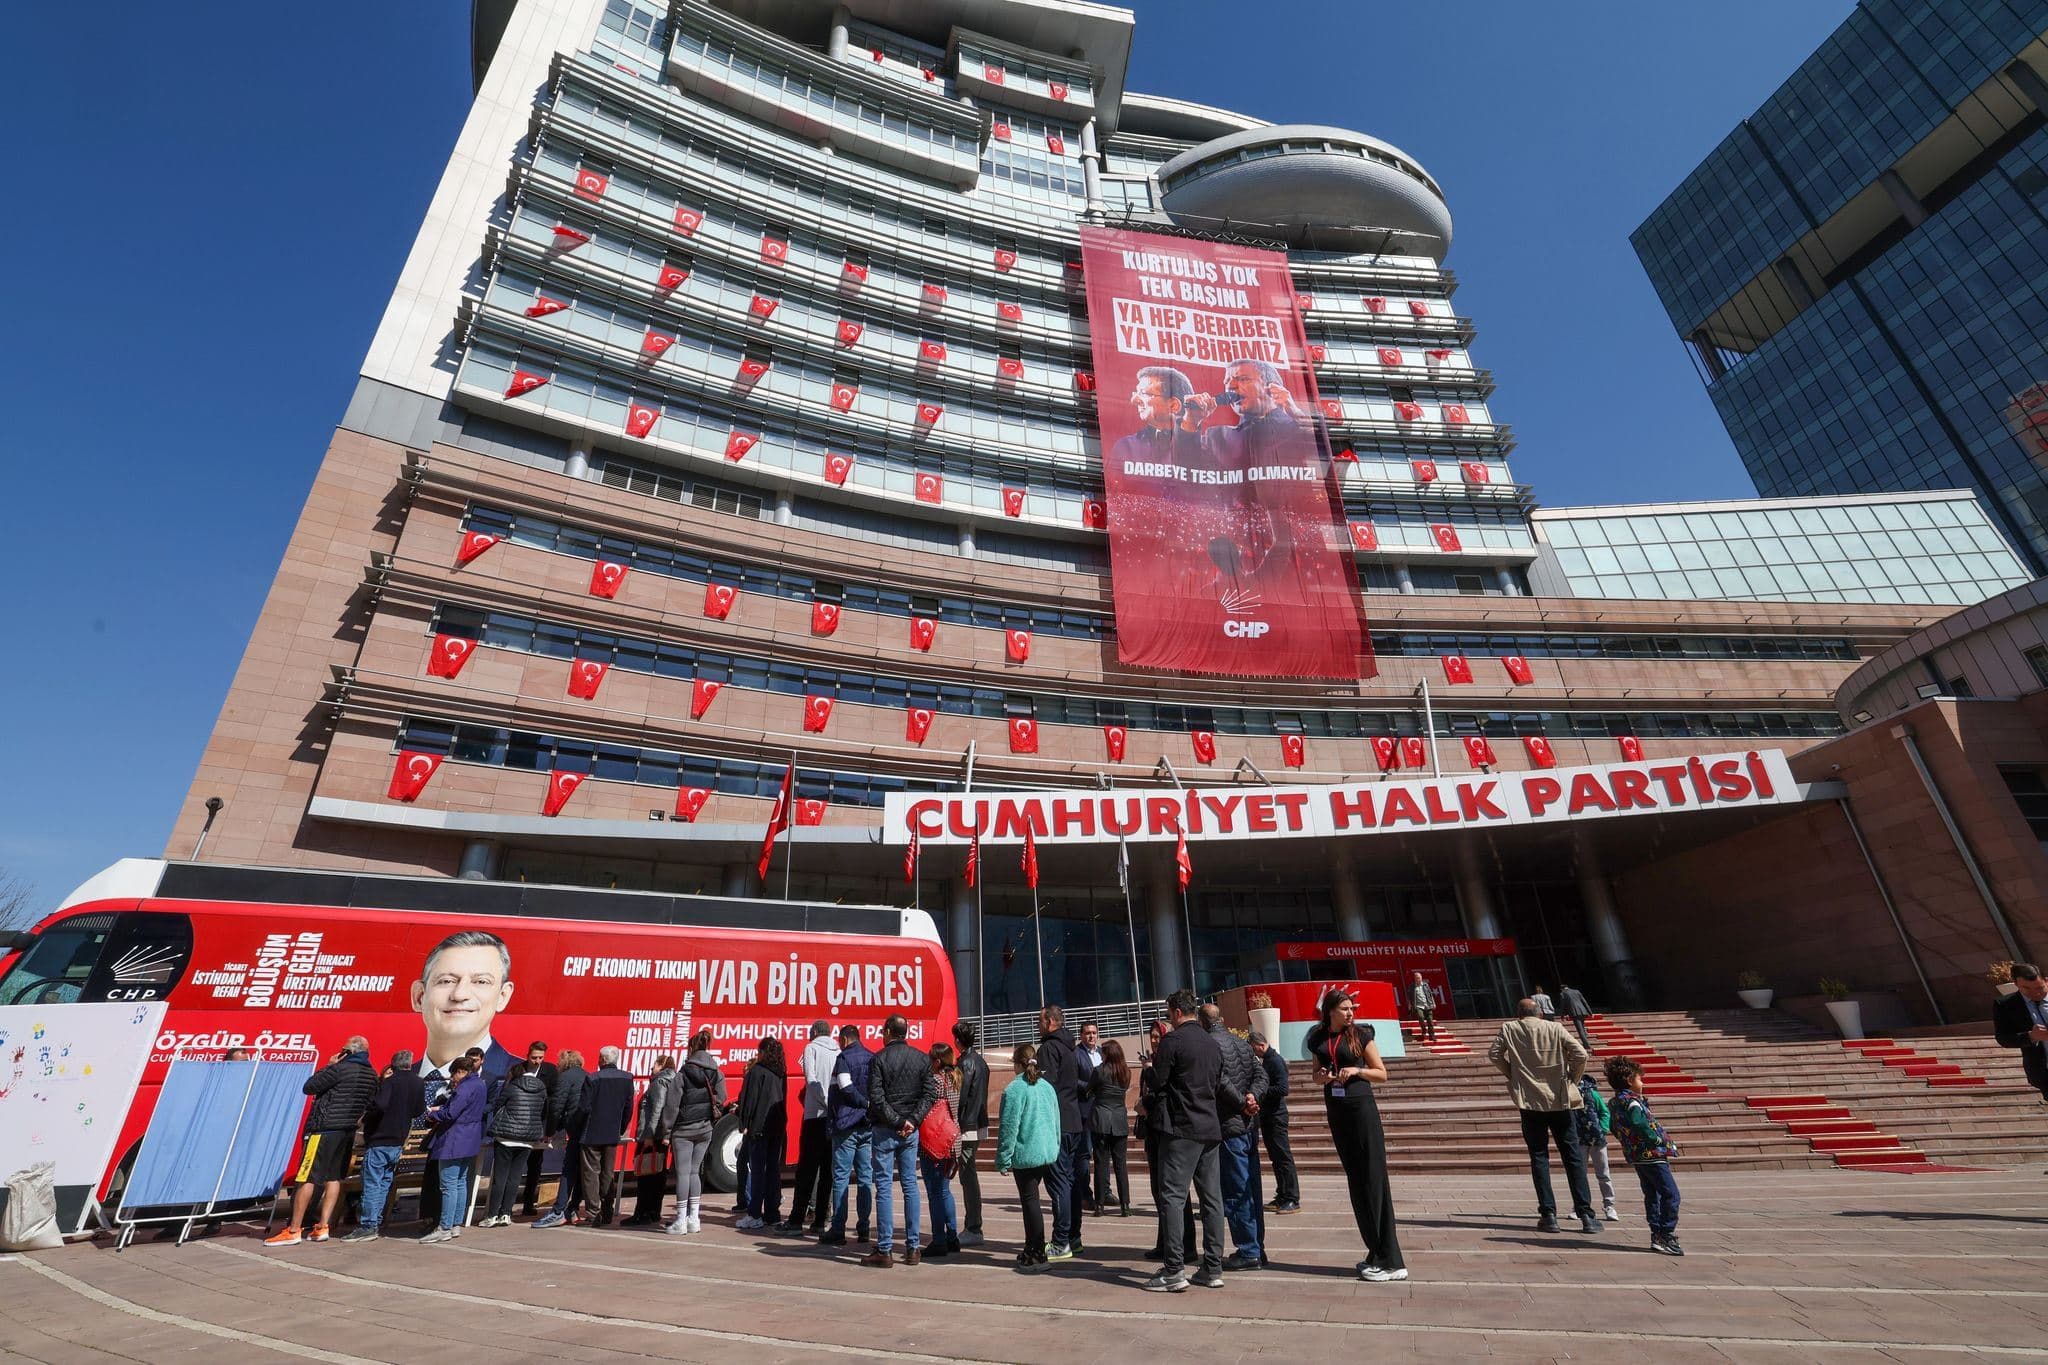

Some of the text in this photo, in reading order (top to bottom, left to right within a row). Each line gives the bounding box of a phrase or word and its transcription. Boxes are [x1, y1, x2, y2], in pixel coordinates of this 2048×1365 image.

[1122, 250, 1260, 287] KURTULUŞ YOK
[1139, 276, 1250, 309] TEK BAŞINA
[1117, 302, 1280, 339] YA HEP BERABER
[1120, 325, 1151, 352] YA
[1124, 460, 1316, 484] DARBEYE TESLİM OLMAYIZ!
[1223, 620, 1269, 638] CHP
[906, 751, 1776, 838] CUMHURİYET HALK PARTİSİ
[288, 932, 324, 974] GELİR
[1327, 942, 1469, 956] CUMHURİYET HALK PARTİSİ
[316, 952, 355, 967] İHRACAT
[564, 956, 696, 980] CHP EKONOMİ TAKIMI
[192, 969, 245, 985] İSTİHDAM
[242, 934, 292, 1007] BÖLÜŞÜM
[212, 985, 242, 998] REFAH
[282, 973, 395, 992] ÜRETİM TASARRUF
[699, 952, 923, 1015] VAR BİR ÇARESİ
[107, 989, 156, 999] CHP
[310, 992, 343, 1009] GELİR
[155, 1030, 315, 1049] ÖZGÜR ÖZEL
[626, 1027, 661, 1047] GIDA
[269, 1050, 315, 1061] PARTİSİ
